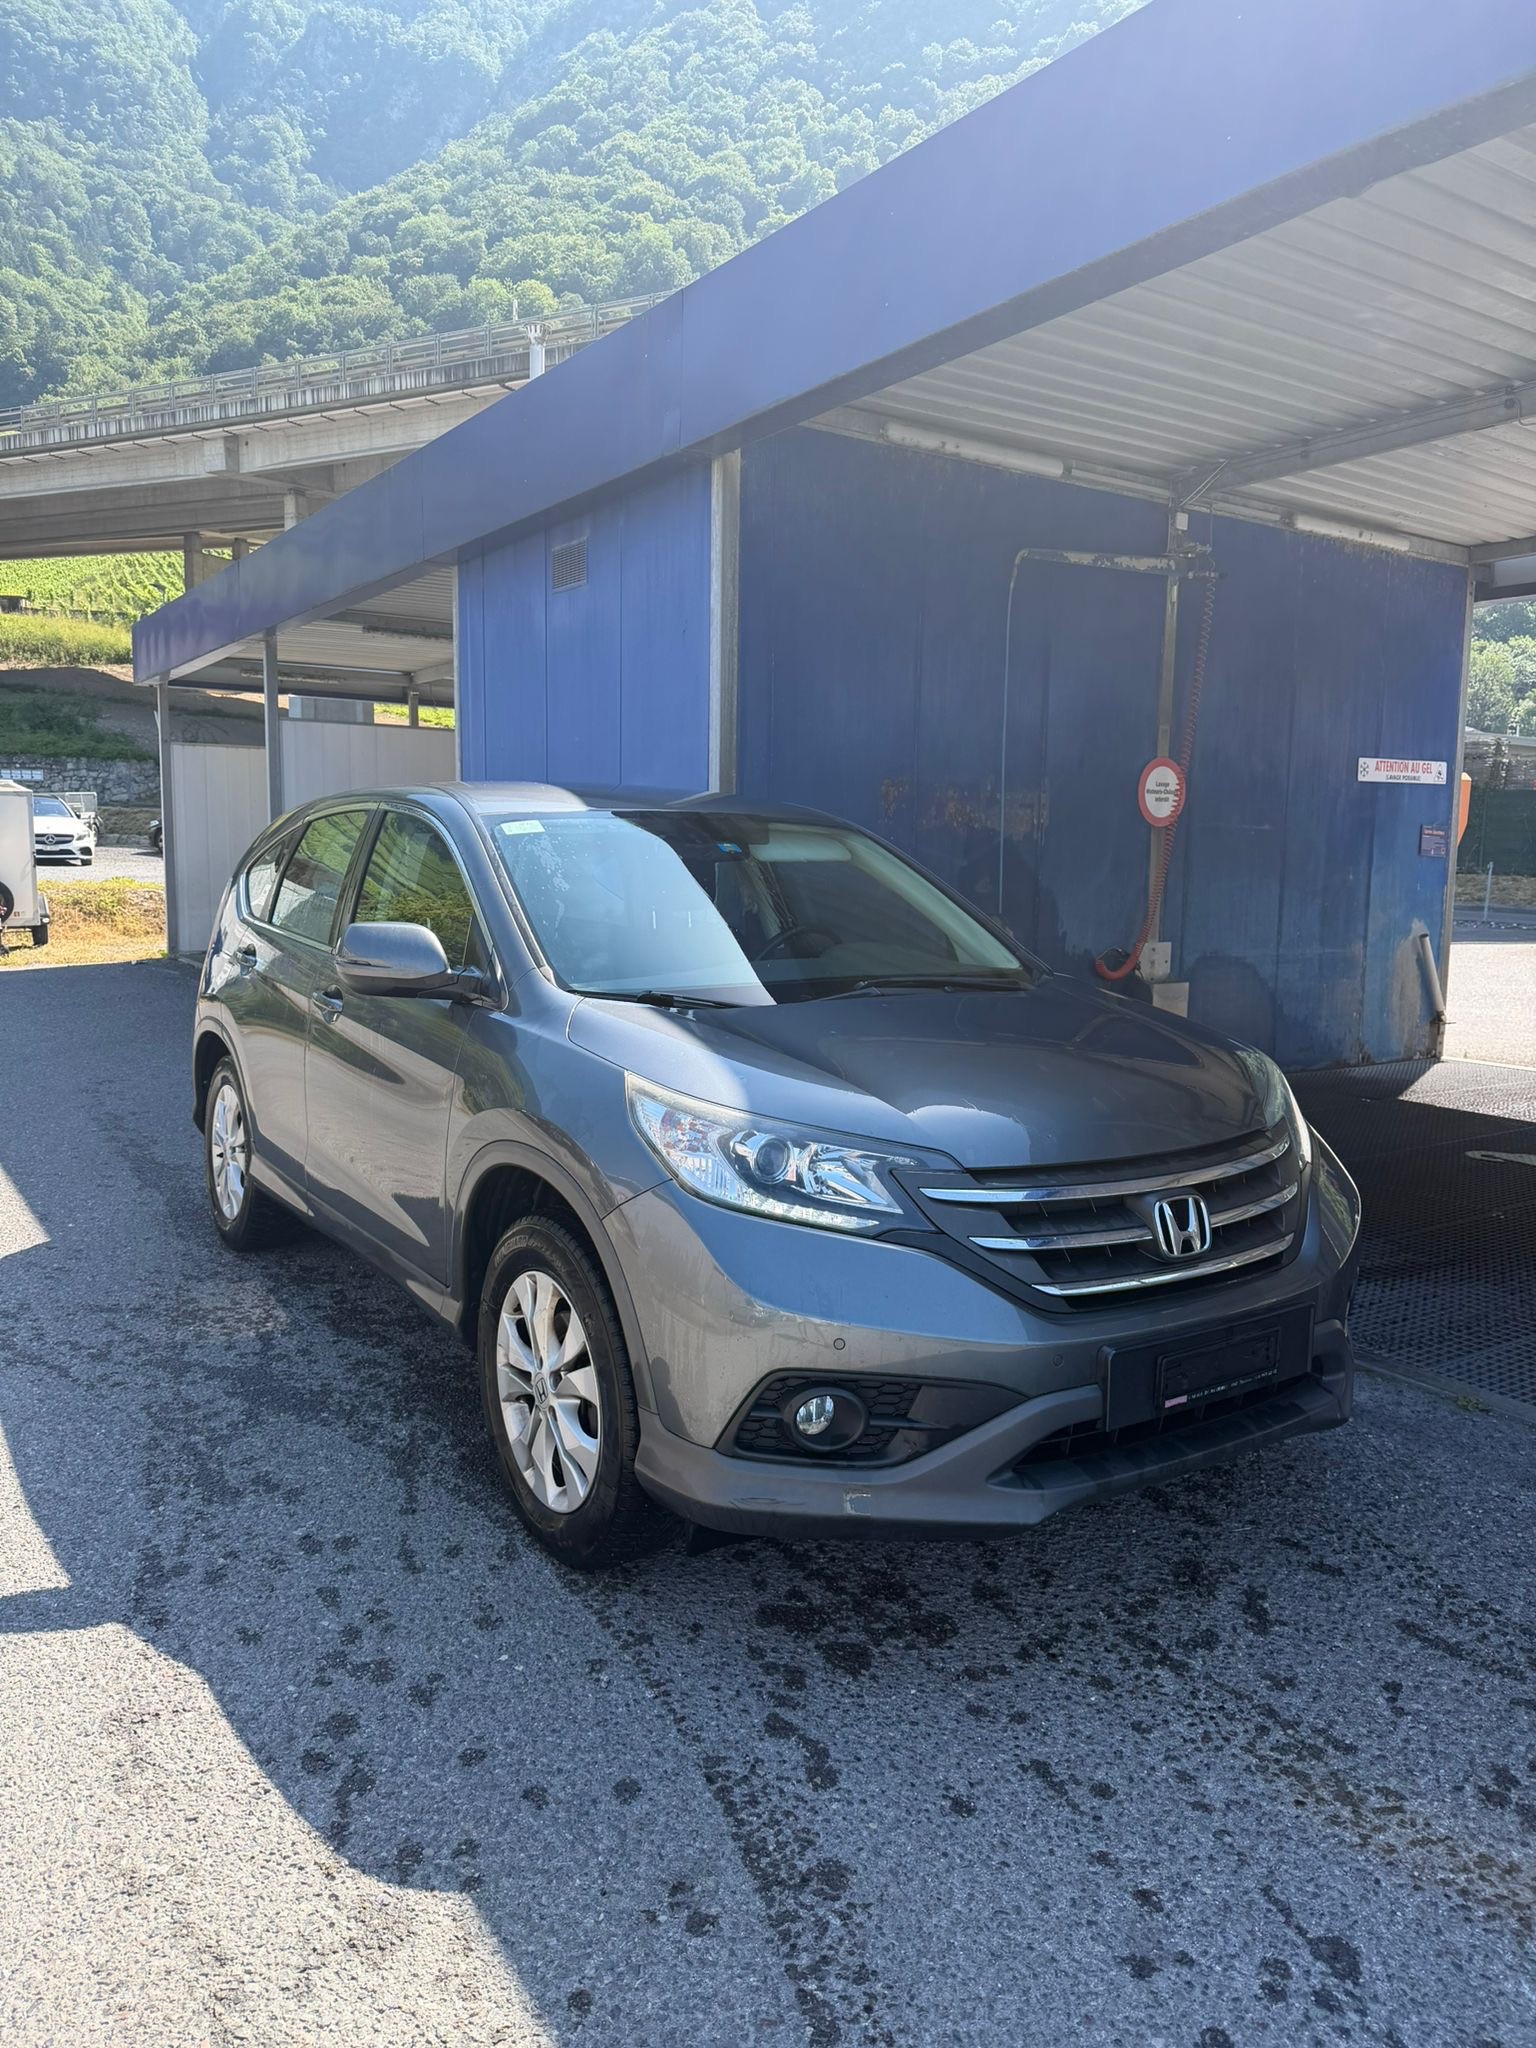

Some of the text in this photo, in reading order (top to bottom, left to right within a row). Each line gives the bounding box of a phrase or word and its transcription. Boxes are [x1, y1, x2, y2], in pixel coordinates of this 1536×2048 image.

[1375, 760, 1433, 775] ATTENTION AU GEL
